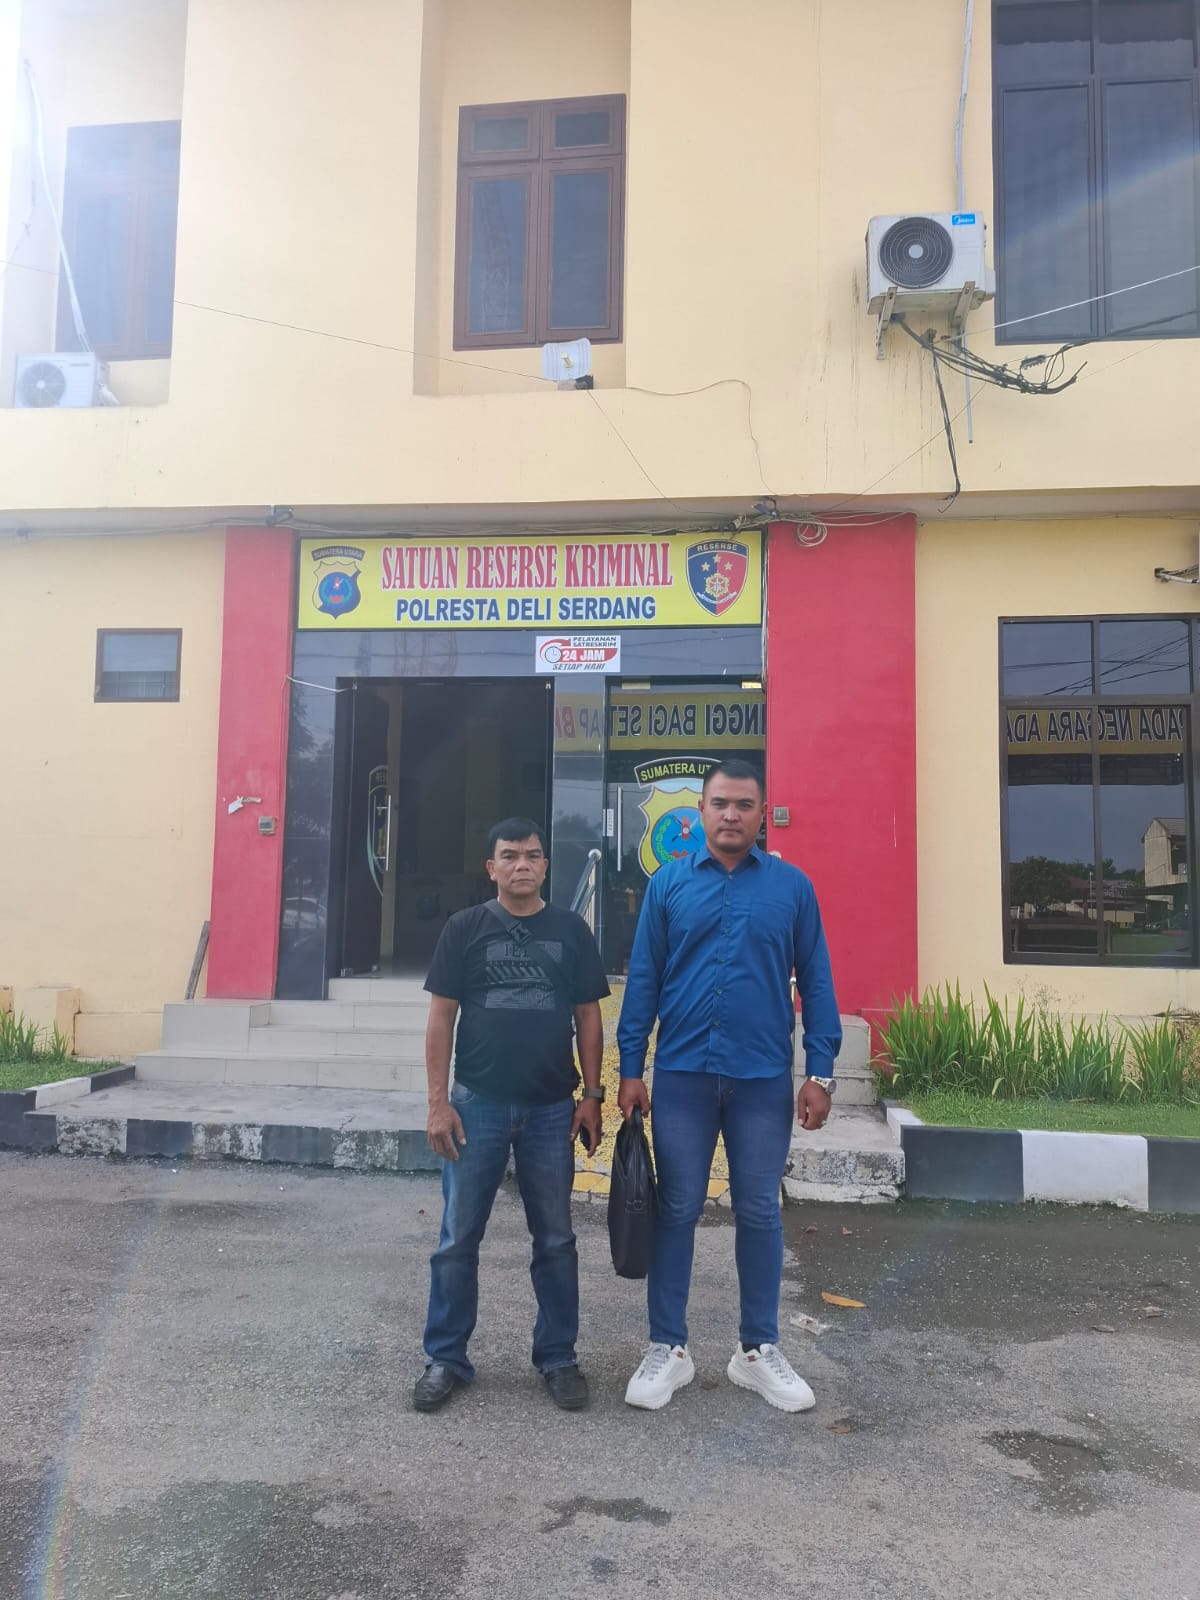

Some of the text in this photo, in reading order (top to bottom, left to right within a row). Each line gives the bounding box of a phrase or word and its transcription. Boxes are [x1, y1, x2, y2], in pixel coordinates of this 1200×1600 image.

[697, 542, 738, 552] RESERSE
[382, 543, 673, 589] SATUAN RESERSE KRIMINAL
[396, 595, 656, 621] POLRESTA DELI SERDANG
[562, 649, 605, 661] 24 JAM
[640, 762, 696, 781] SUMATERA
